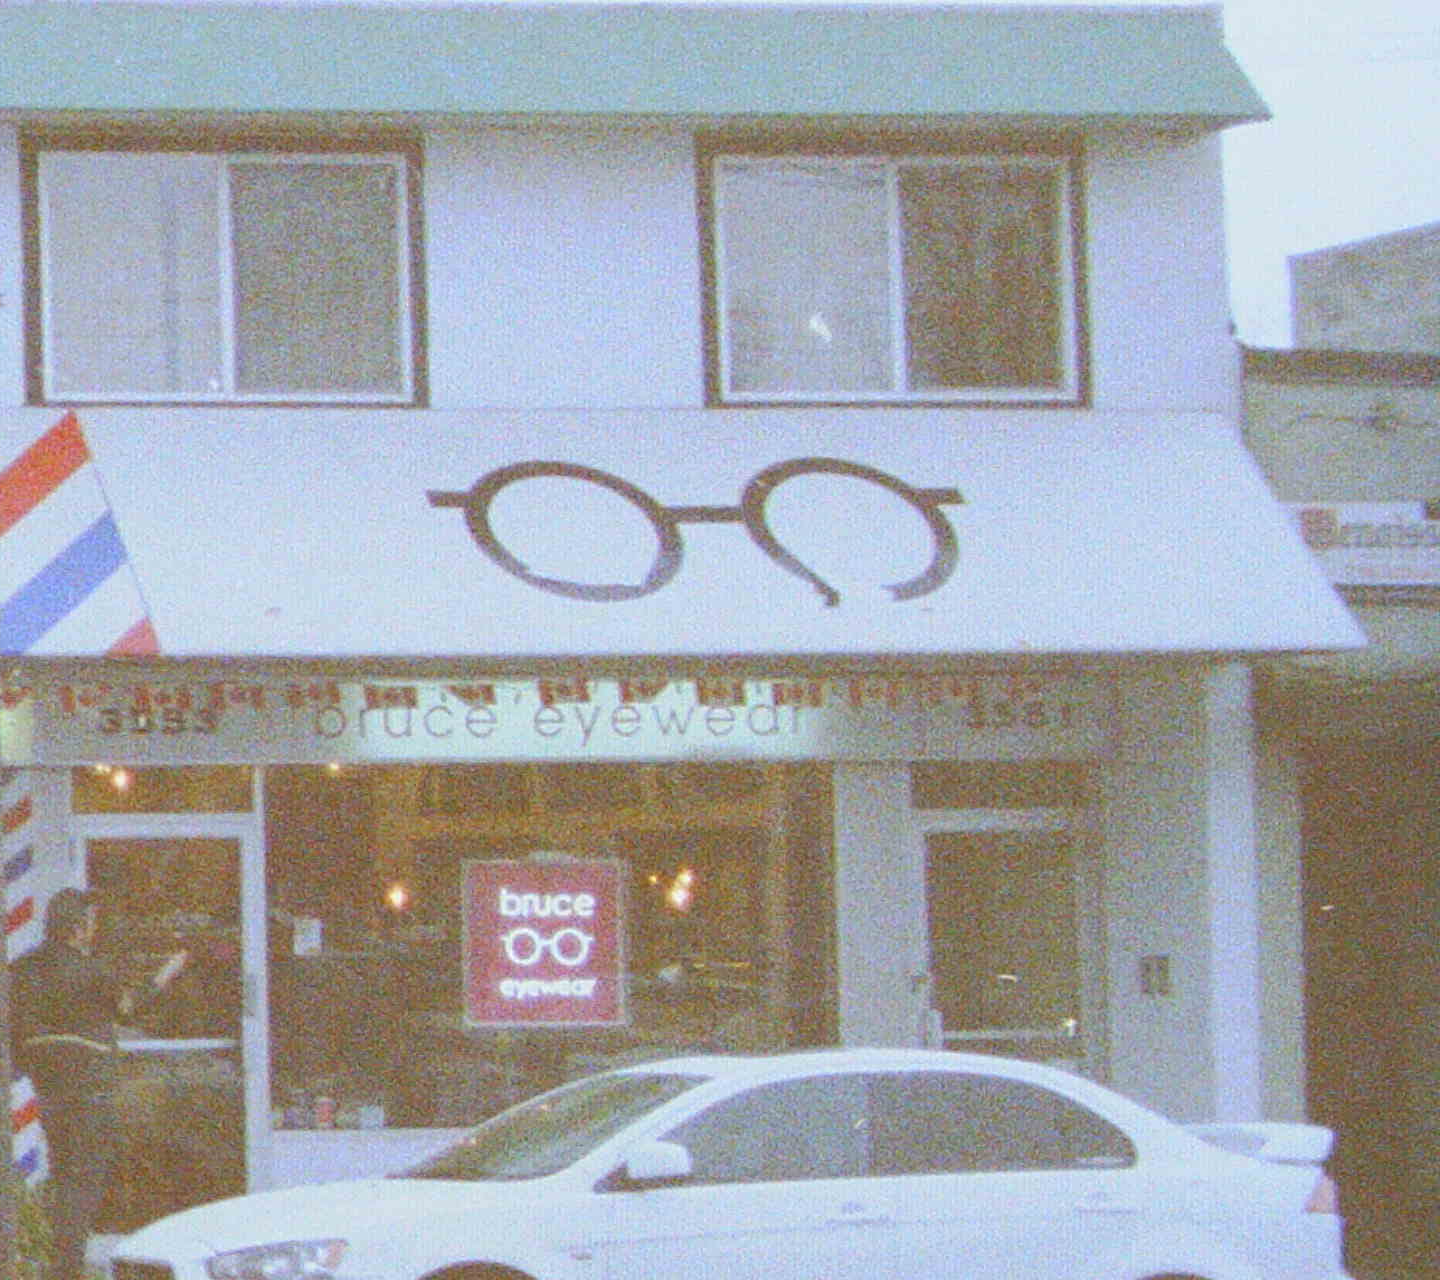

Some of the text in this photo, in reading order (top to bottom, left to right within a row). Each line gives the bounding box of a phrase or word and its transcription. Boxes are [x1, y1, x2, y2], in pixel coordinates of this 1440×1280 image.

[312, 695, 808, 747] bruce eyewear
[498, 886, 597, 918] bruce
[498, 976, 598, 999] eyewear
